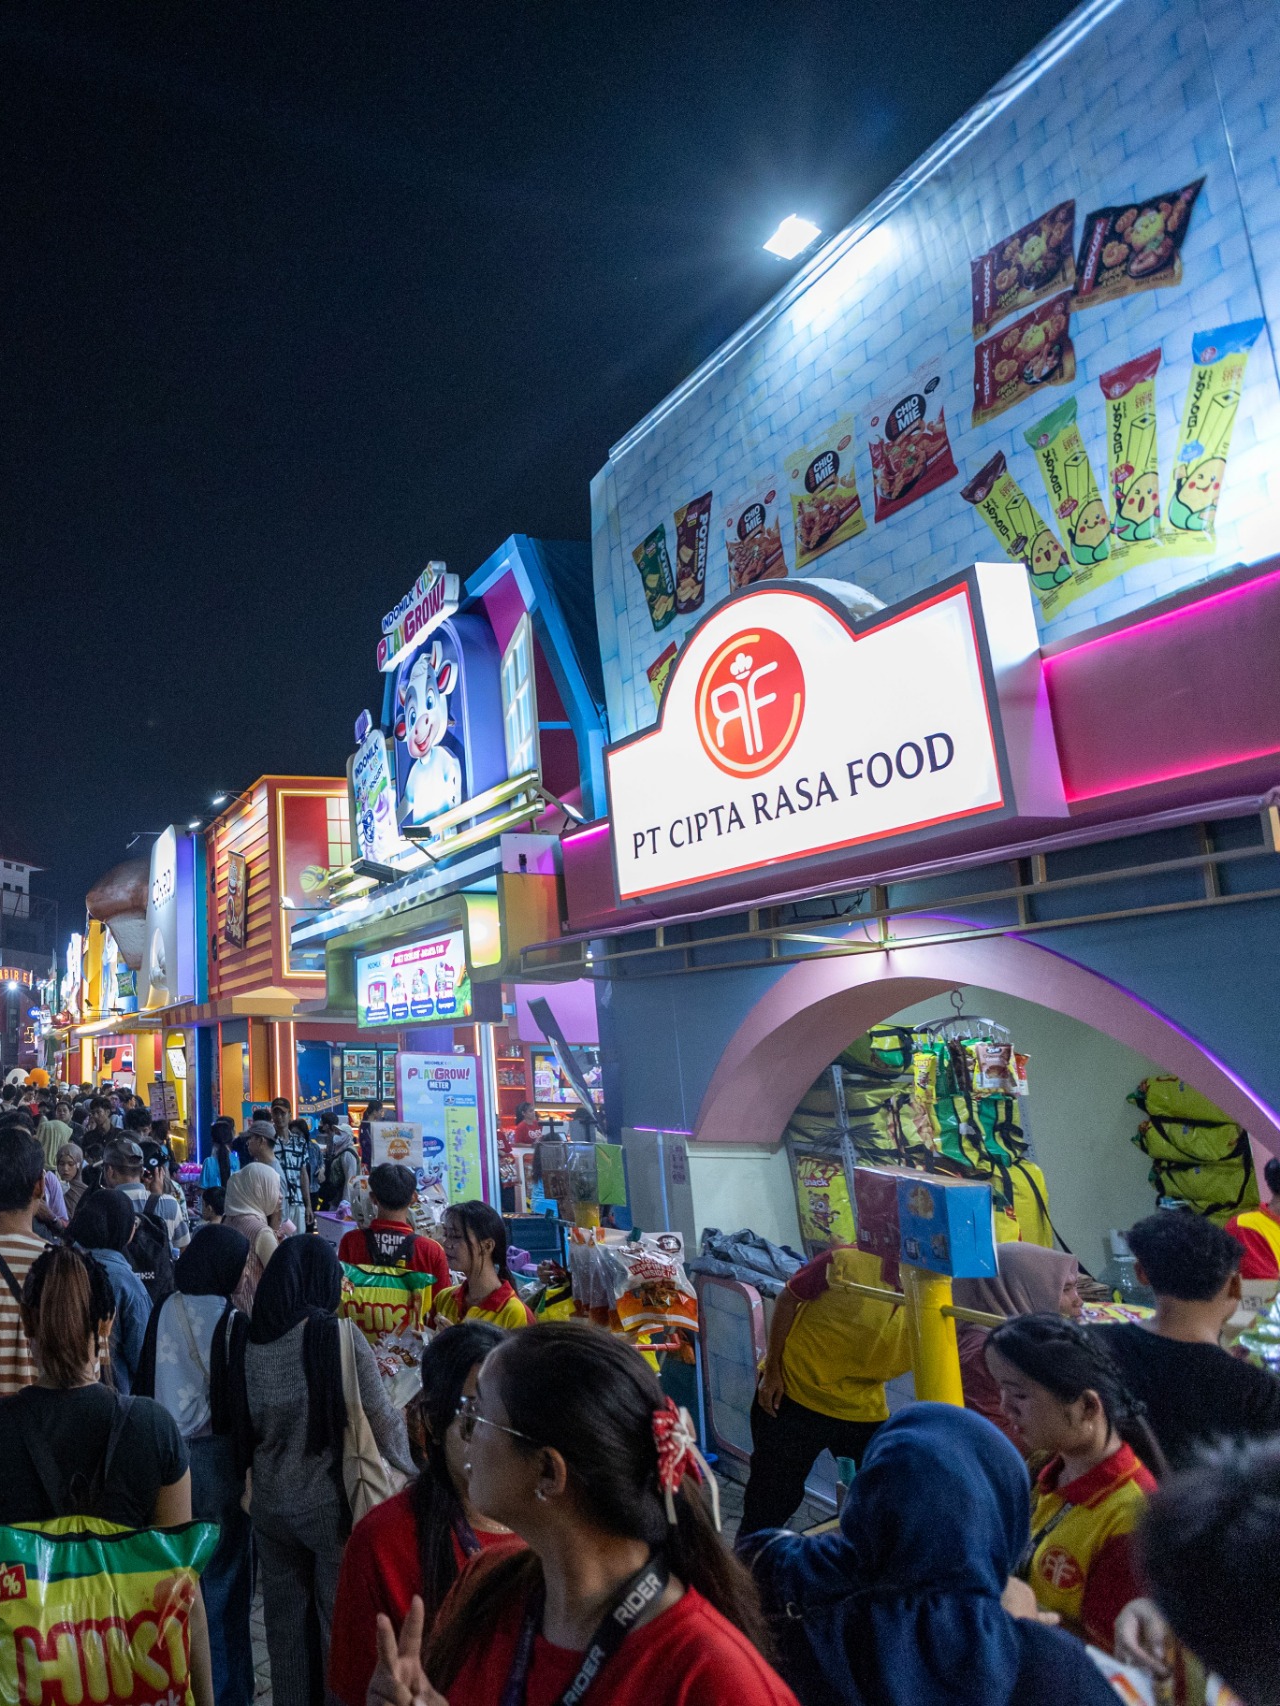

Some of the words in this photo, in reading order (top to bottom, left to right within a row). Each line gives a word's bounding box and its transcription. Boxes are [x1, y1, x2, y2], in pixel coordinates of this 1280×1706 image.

[895, 395, 920, 420] CHIO
[897, 406, 922, 432] MIE
[813, 452, 834, 473] CHIO
[815, 463, 835, 486] MIE
[744, 505, 761, 523] CHIO
[745, 516, 763, 534] MIE
[382, 590, 415, 634] INDOMILK
[632, 826, 662, 860] PT
[669, 801, 747, 848] CIPTA
[751, 770, 839, 825] RASA
[846, 731, 955, 798] FOOD
[407, 1067, 470, 1080] PLAYGROW!
[429, 1080, 449, 1089] METER
[613, 1572, 663, 1625] RIDER
